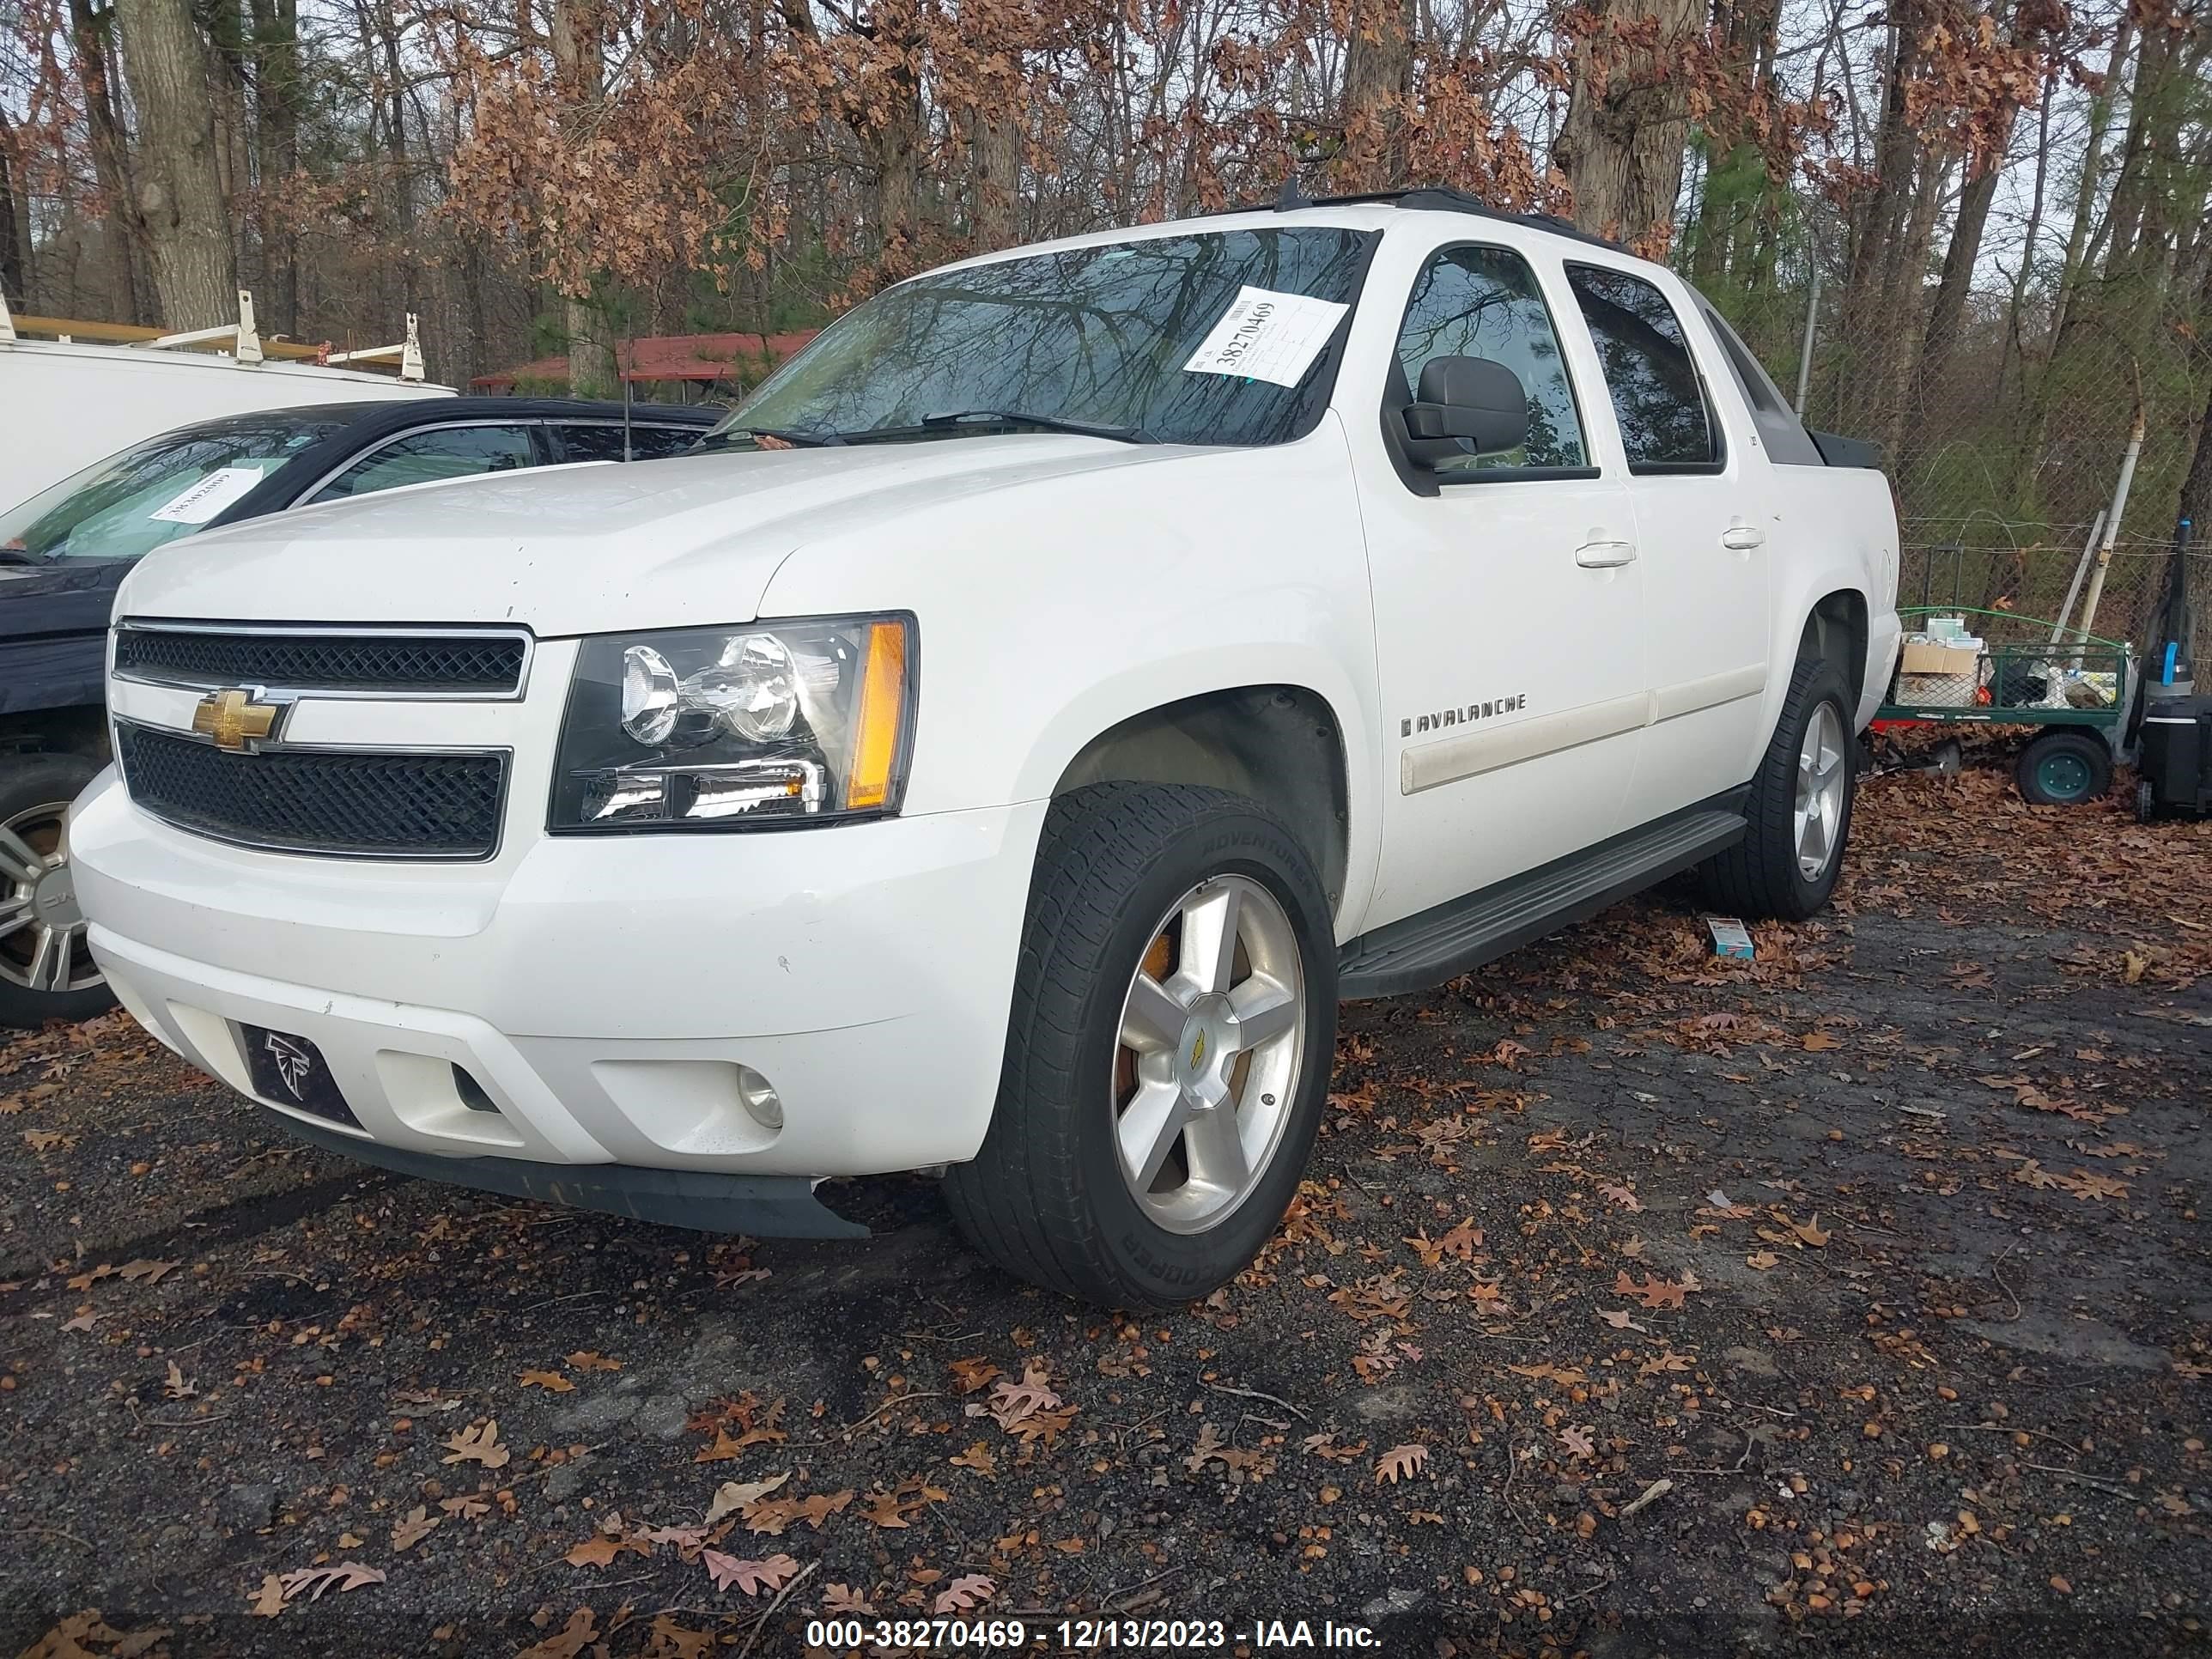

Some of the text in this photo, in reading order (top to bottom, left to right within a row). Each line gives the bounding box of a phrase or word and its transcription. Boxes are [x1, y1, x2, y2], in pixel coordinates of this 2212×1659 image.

[1216, 302, 1275, 367] 38270469
[1416, 693, 1527, 733] AVALANCHE
[1200, 830, 1314, 898] ADVENTURER
